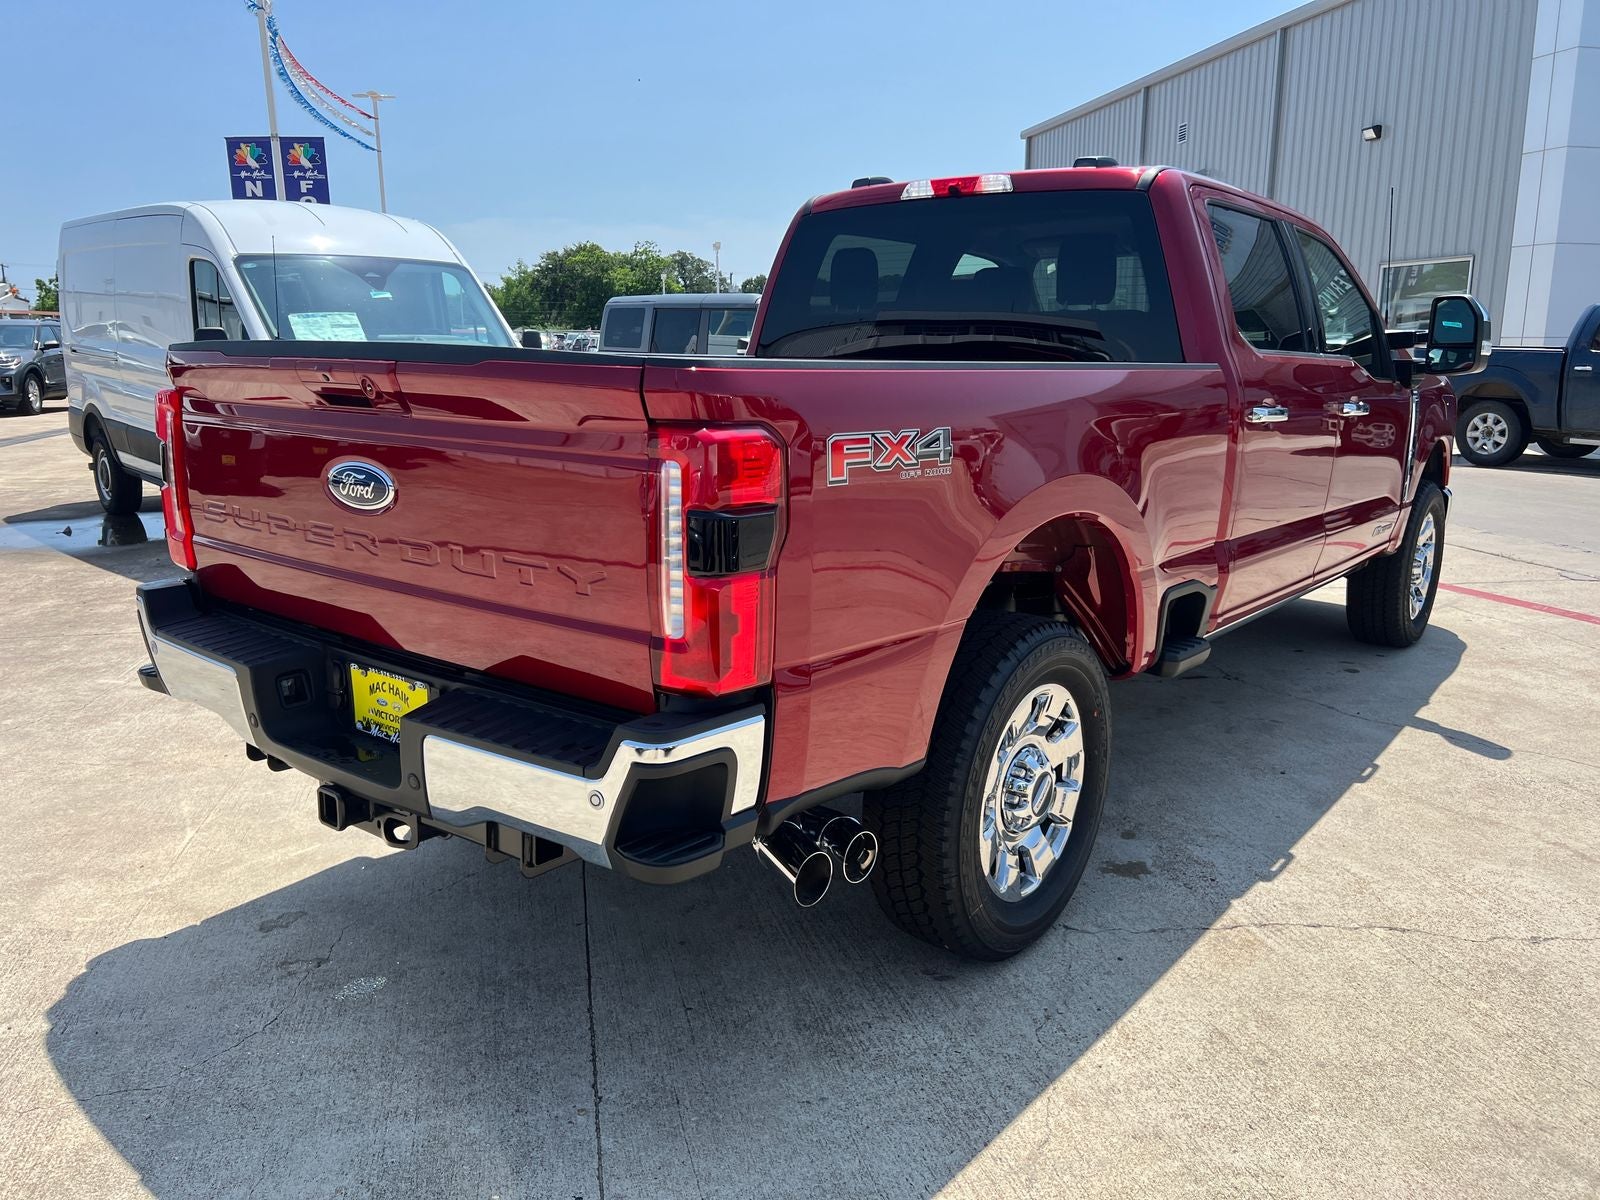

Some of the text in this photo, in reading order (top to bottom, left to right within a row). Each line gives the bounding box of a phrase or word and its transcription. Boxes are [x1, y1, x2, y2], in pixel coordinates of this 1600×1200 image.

[245, 180, 263, 197] N
[827, 426, 953, 487] FX4
[900, 470, 921, 479] OFF
[339, 471, 375, 499] Ford
[202, 500, 607, 596] SUPER DUTY
[369, 681, 387, 696] MAC
[373, 707, 400, 724] VICTOR
